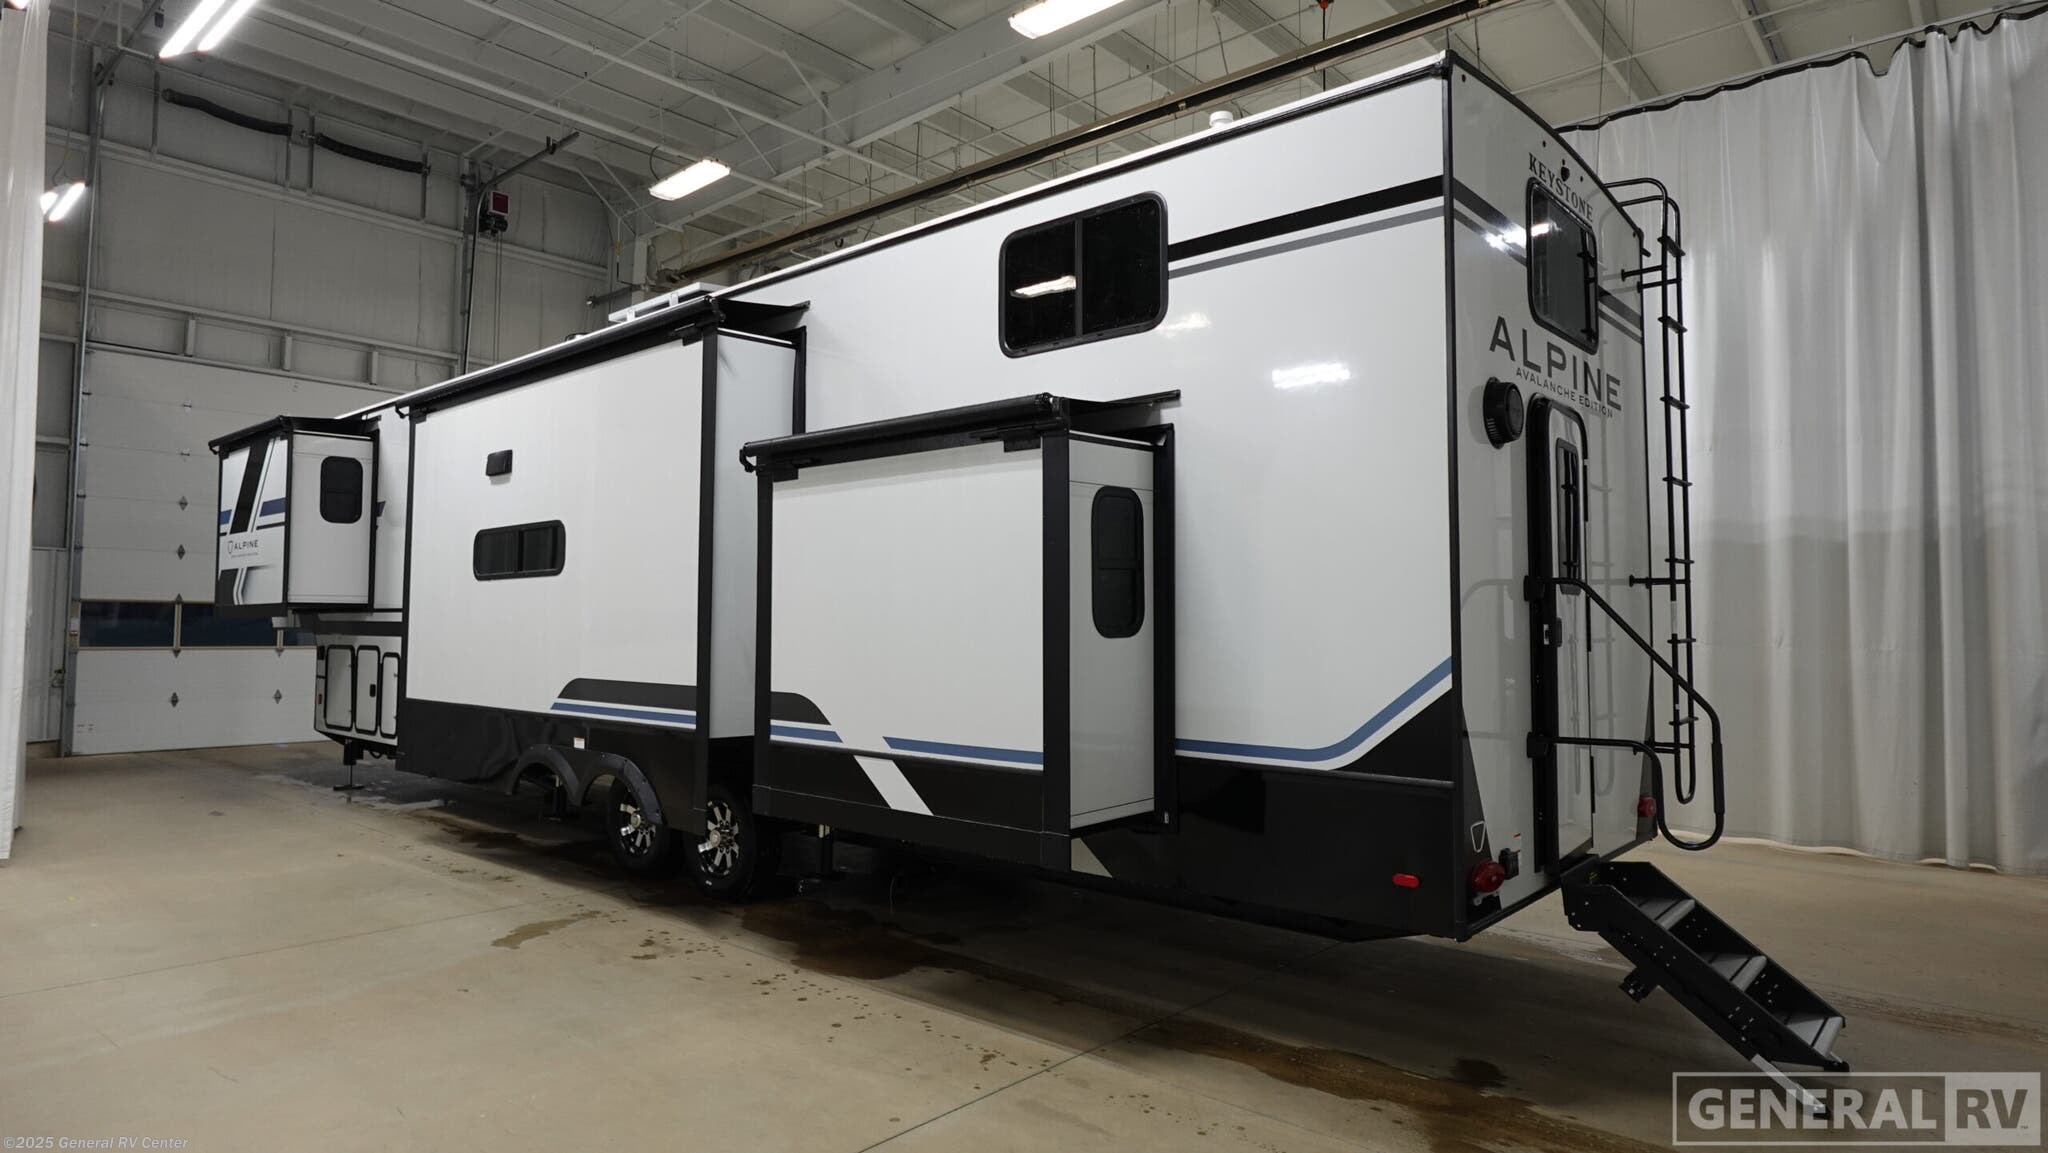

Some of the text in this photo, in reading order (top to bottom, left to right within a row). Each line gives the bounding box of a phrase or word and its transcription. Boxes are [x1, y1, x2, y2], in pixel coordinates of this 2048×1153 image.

[1529, 152, 1594, 223] KEYSTONE
[1489, 315, 1622, 411] ALPINE
[1515, 367, 1613, 418] AVALANCHE EDITION
[233, 539, 259, 550] ALPINE
